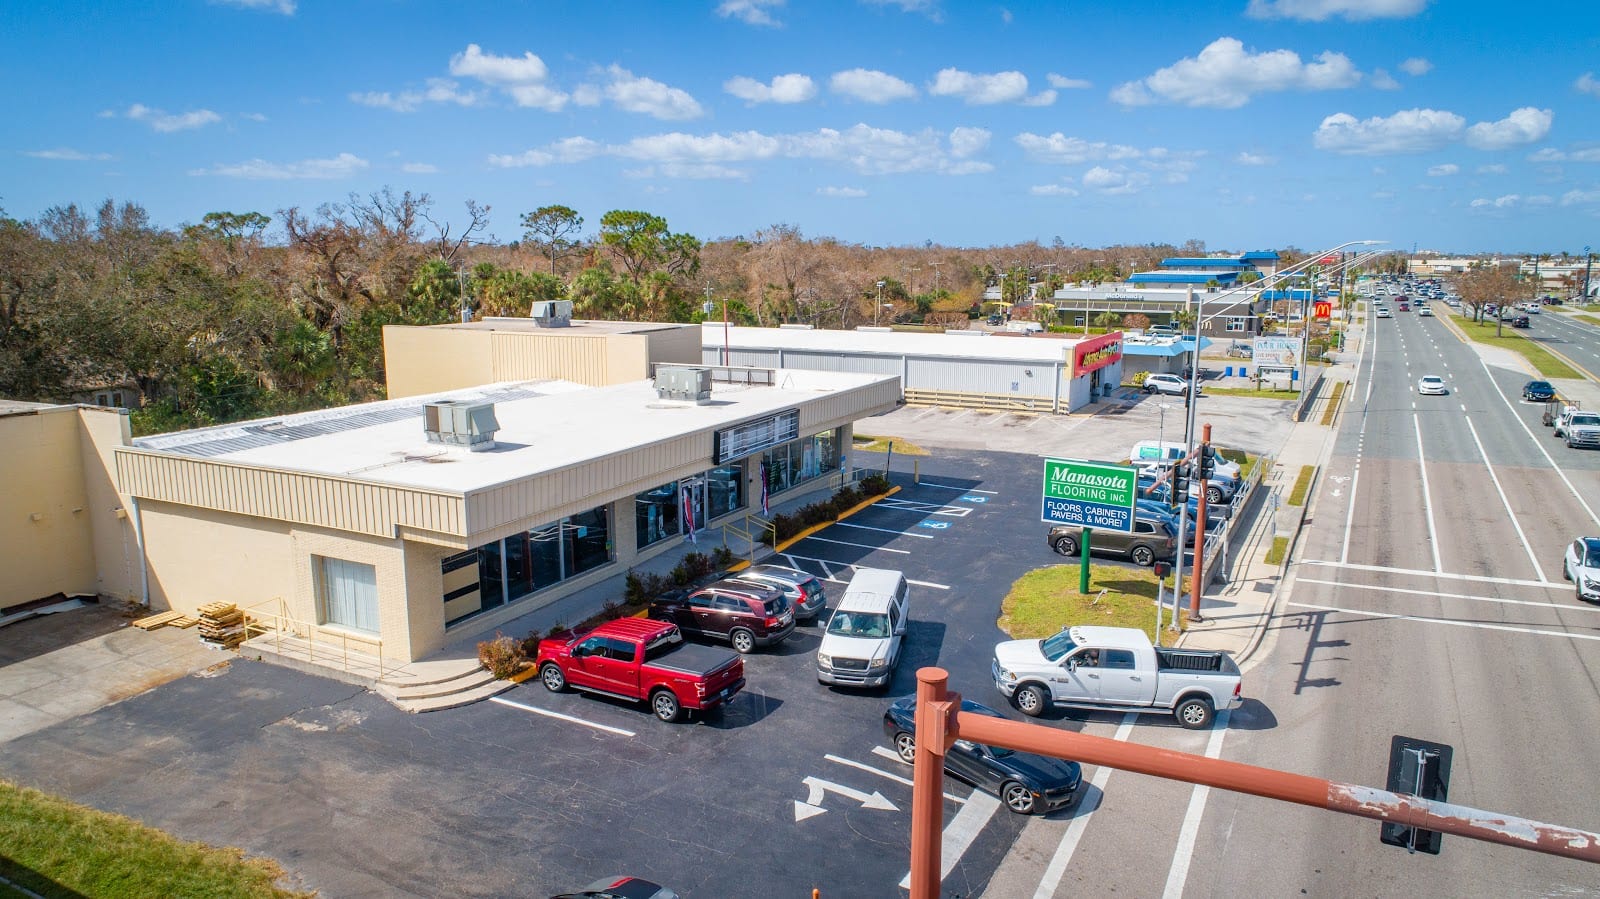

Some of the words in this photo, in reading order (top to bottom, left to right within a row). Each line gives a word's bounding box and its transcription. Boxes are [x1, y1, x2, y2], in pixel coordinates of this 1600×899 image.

[1051, 466, 1128, 489] Manasota
[1051, 485, 1106, 500] FLOORING
[1110, 493, 1126, 503] INC.
[1047, 501, 1083, 514] FLOORS,
[1085, 506, 1128, 520] CABINETS
[1050, 510, 1085, 523] PAVERS,
[1086, 514, 1093, 523] &
[1094, 516, 1123, 528] MORE!
